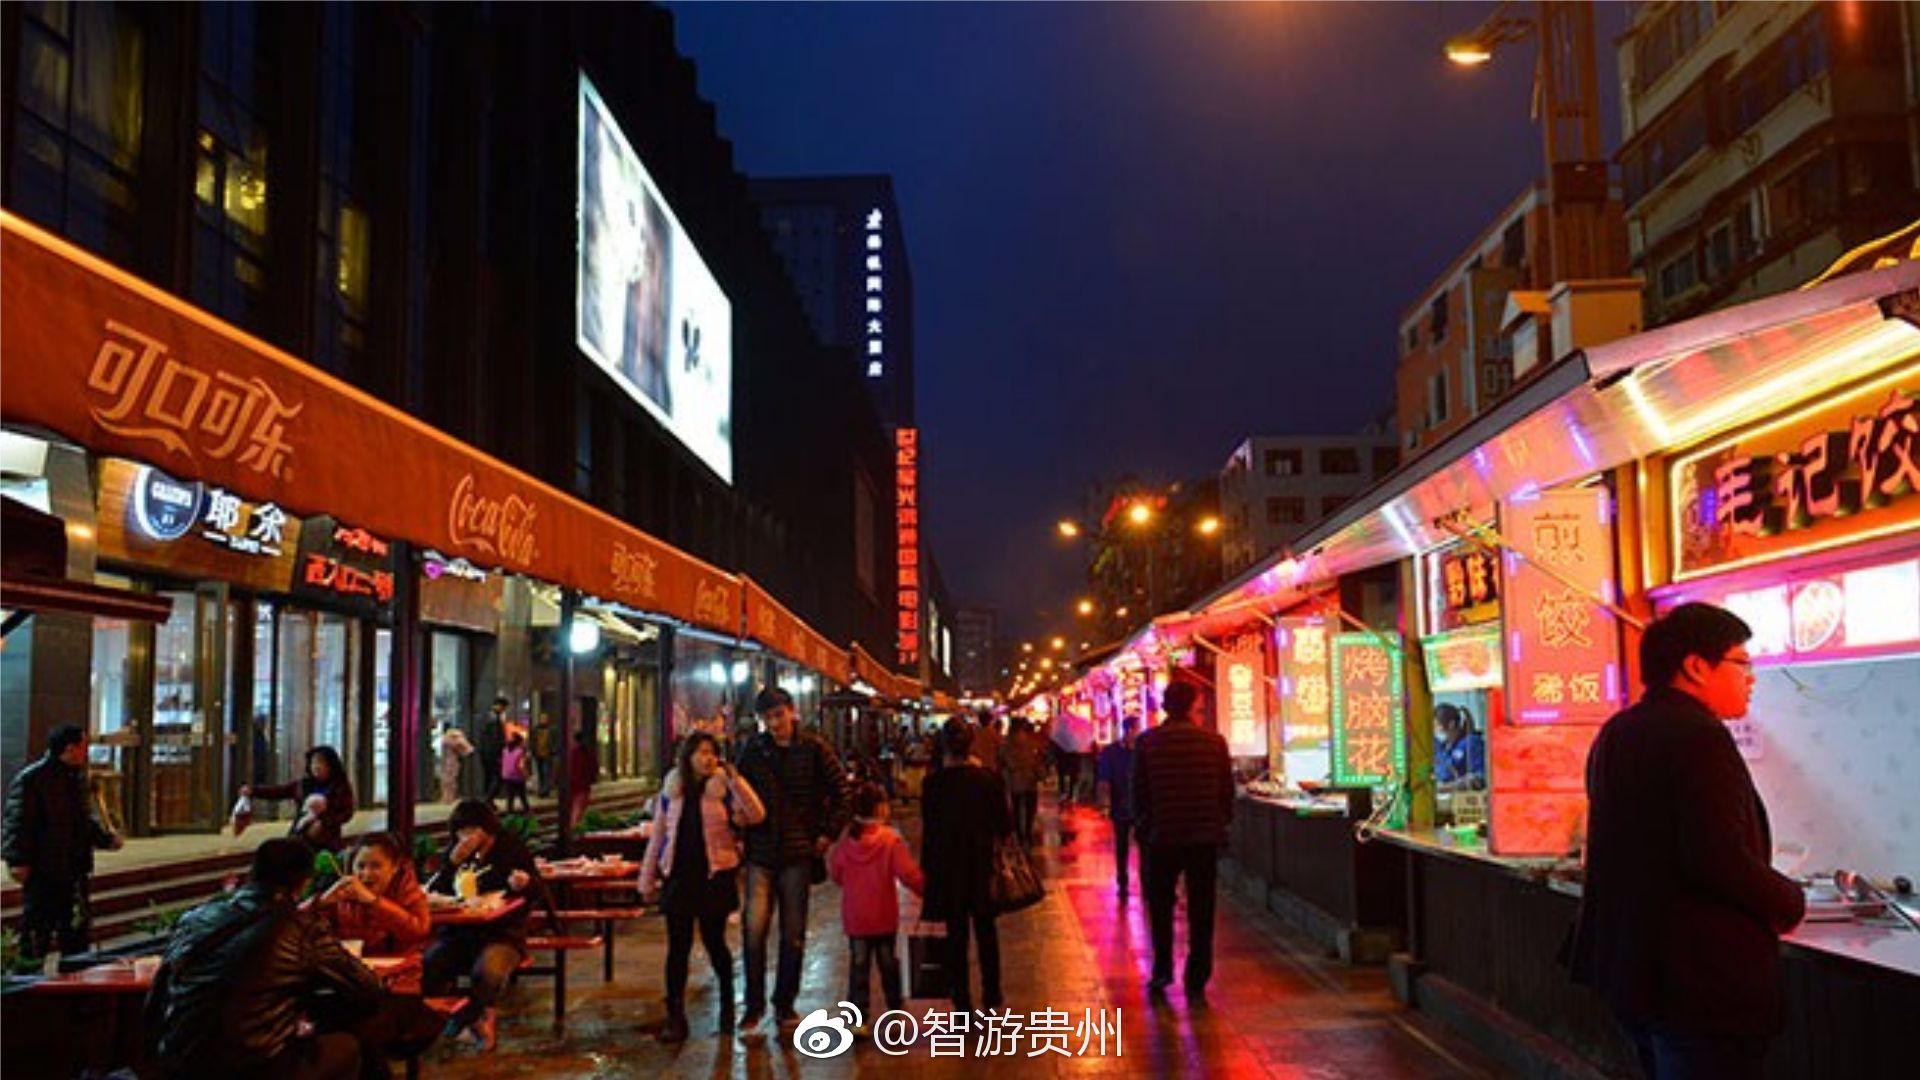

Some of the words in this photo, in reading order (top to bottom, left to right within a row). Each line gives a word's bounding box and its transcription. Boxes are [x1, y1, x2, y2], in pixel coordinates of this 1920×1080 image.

[88, 319, 303, 482] 可口可乐
[1533, 512, 1594, 648] 煎饺
[1344, 645, 1393, 776] 烤脑花
